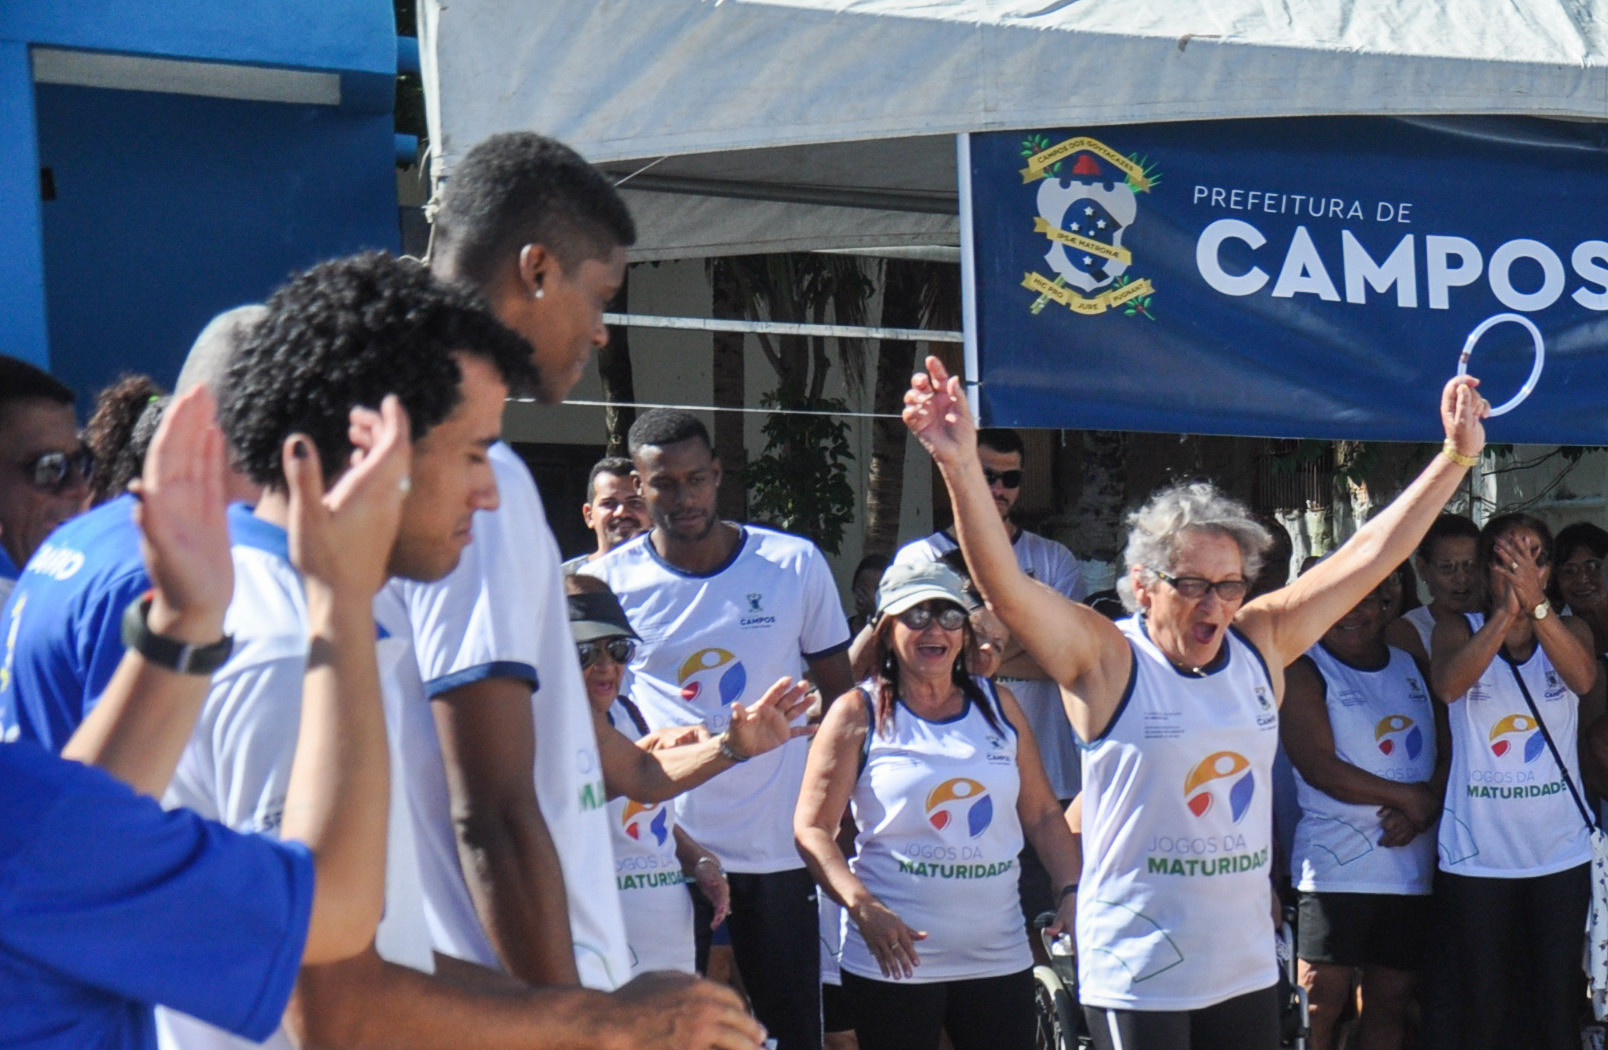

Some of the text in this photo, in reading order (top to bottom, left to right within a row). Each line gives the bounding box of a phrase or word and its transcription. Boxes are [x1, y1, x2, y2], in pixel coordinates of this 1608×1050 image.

[1037, 145, 1068, 163] CAMPOS
[1069, 140, 1085, 149] DOS
[1193, 185, 1413, 223] PREFEITURA DE
[1047, 285, 1064, 299] PRO
[1516, 770, 1535, 783] DA
[902, 843, 983, 861] JOGOS DA
[1147, 833, 1247, 855] JOGOS DA
